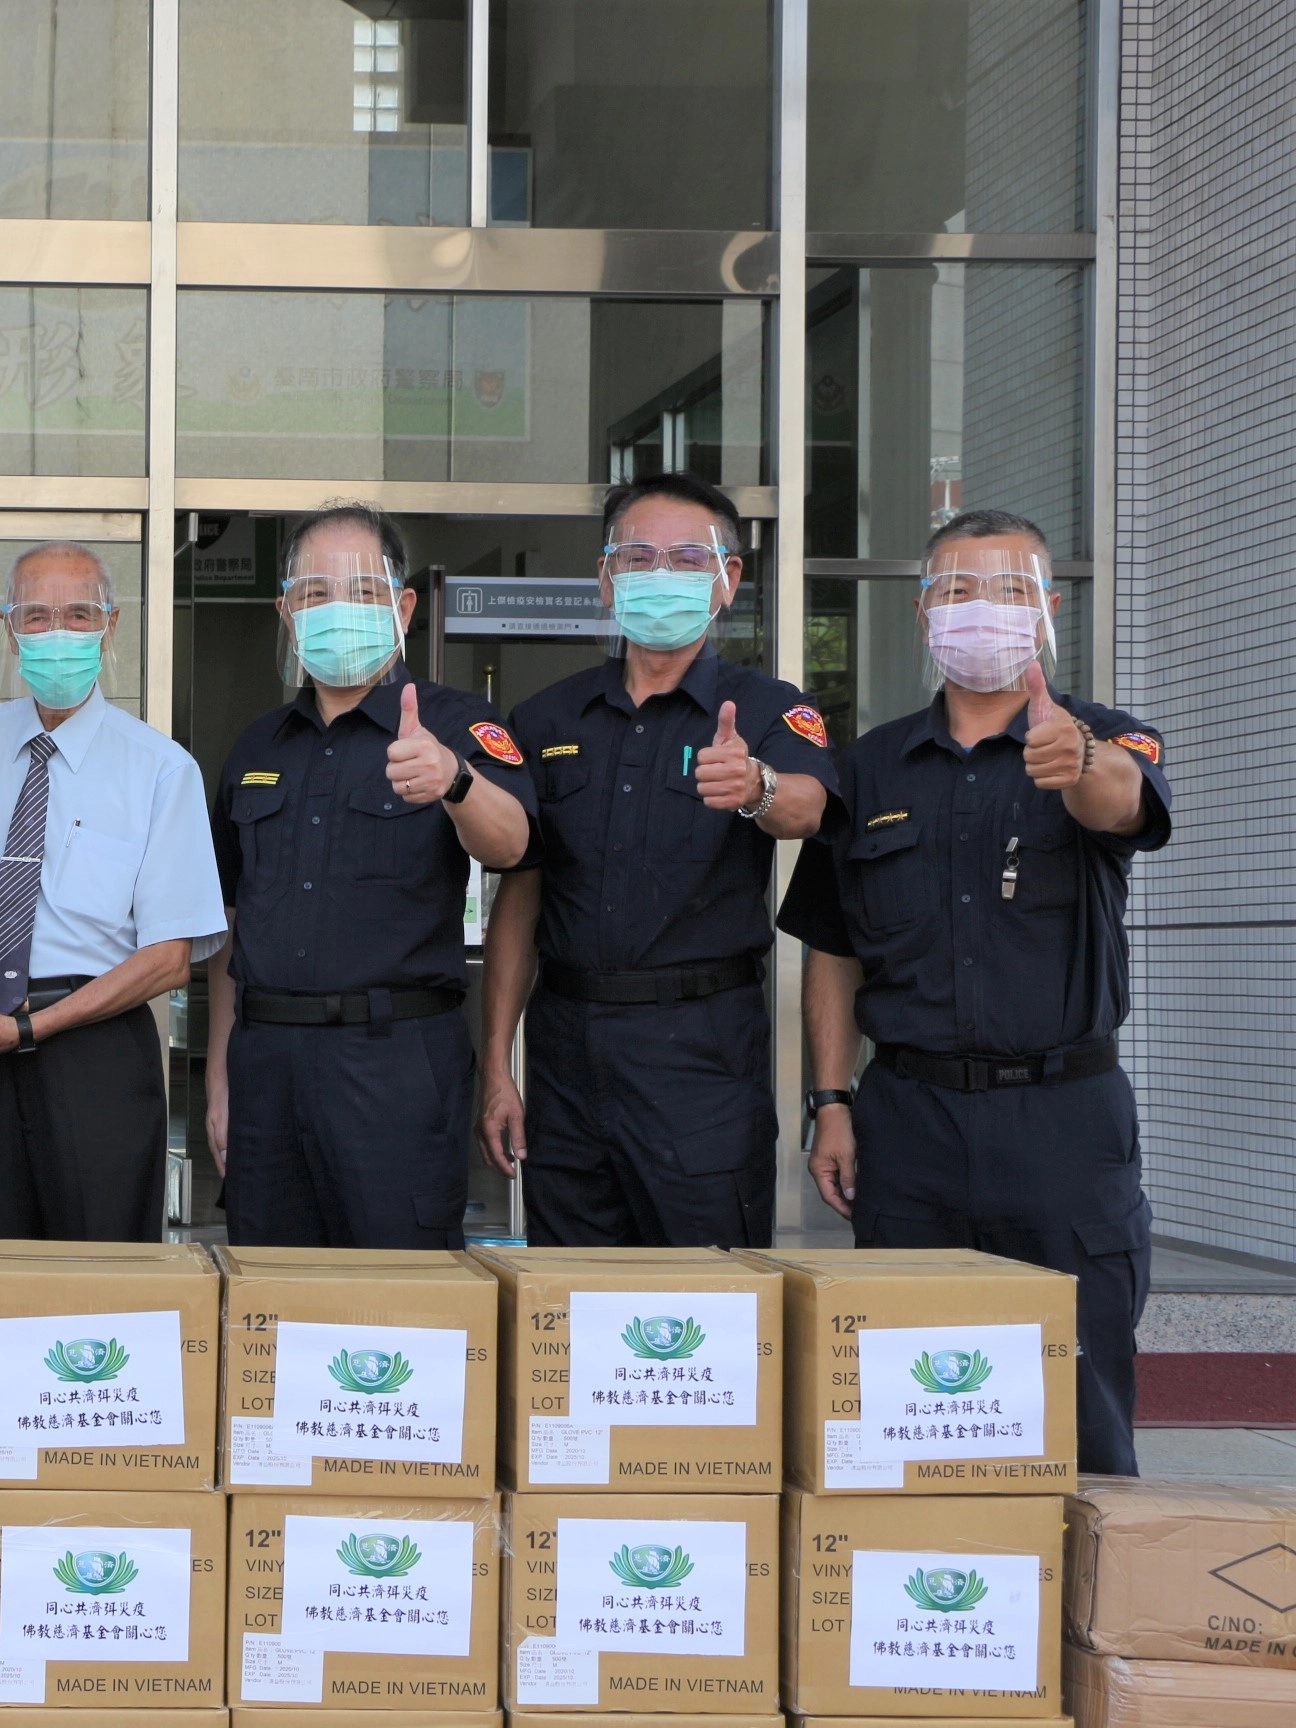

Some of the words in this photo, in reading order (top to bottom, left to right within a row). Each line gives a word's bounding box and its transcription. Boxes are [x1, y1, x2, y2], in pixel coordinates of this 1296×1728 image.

[243, 1313, 278, 1331] 12"
[531, 1312, 567, 1331] 12"
[831, 1315, 867, 1334] 12"
[532, 1343, 570, 1355] VINY
[532, 1370, 569, 1383] SIZE
[242, 1397, 274, 1411] LOT
[532, 1397, 564, 1410] LOT
[592, 1390, 735, 1405] 佛教慈濟基金會關心您
[832, 1400, 861, 1413] LOT
[18, 1410, 162, 1430] 佛教慈濟基金會關心您
[296, 1421, 441, 1441] 佛教慈濟基金會關心您
[883, 1422, 1023, 1441] 佛教慈濟基金會關心您
[45, 1451, 94, 1466] MADE
[100, 1453, 116, 1466] IN
[122, 1454, 199, 1469] VIETNAM
[325, 1459, 374, 1474] MADE
[380, 1460, 396, 1474] IN
[402, 1462, 479, 1477] VIETNAM
[620, 1461, 668, 1475] MADE
[674, 1462, 689, 1474] IN
[696, 1461, 772, 1475] VIETNAM
[918, 1464, 965, 1478] MADE
[972, 1464, 987, 1478] IN
[993, 1464, 1067, 1477] VIETNAM
[245, 1529, 281, 1548] 12"
[812, 1534, 848, 1552] 12"
[246, 1560, 284, 1573] VINY
[813, 1564, 852, 1577] VINY
[245, 1587, 283, 1599] SIZE
[812, 1592, 850, 1605] SIZE
[245, 1614, 277, 1627] LOT
[306, 1606, 449, 1625] 佛教慈濟基金會關心您
[526, 1616, 557, 1629] LOT
[23, 1624, 167, 1641] 佛教慈濟基金會關心您
[579, 1618, 723, 1636] 佛教慈濟基金會關心您
[812, 1619, 844, 1632] LOT
[1208, 1615, 1263, 1635] C/NO:
[873, 1641, 1016, 1660] 佛教慈濟基金會關心您
[1204, 1637, 1262, 1653] MADE
[1267, 1641, 1285, 1656] IN
[57, 1679, 106, 1692] MADE
[113, 1679, 128, 1692] IN
[134, 1679, 211, 1692] VIETNAM
[332, 1681, 381, 1694] MADE
[388, 1682, 403, 1694] IN
[409, 1682, 486, 1695] VIETNAM
[610, 1677, 658, 1691] MADE
[665, 1678, 681, 1691] IN
[687, 1679, 764, 1693] VIETNAM
